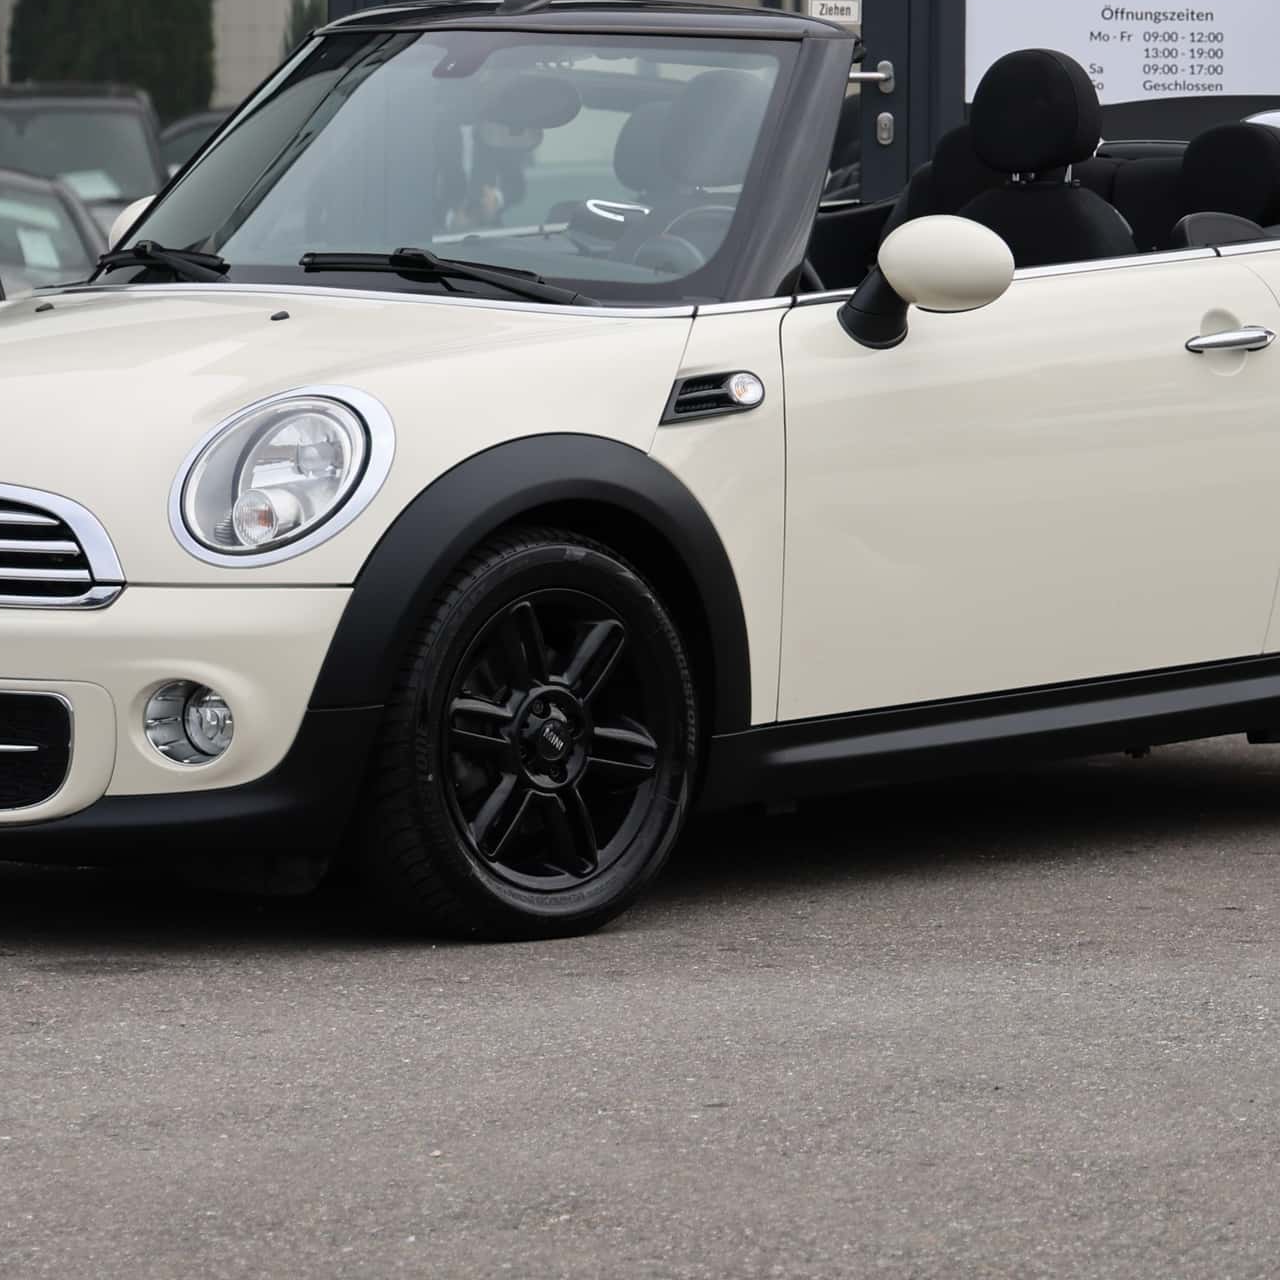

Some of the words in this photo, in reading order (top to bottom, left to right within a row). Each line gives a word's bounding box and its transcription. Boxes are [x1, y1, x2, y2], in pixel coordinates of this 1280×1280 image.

[819, 3, 852, 16] Ziehen
[1101, 4, 1214, 24] Öffnungszeiten
[1089, 31, 1110, 42] Mo
[1120, 31, 1132, 42] Fr
[1143, 31, 1178, 42] 09:00
[1190, 31, 1224, 43] 12:00
[1144, 47, 1178, 59] 13:00
[1189, 47, 1224, 59] 19:00
[1089, 63, 1104, 75] Sa
[1143, 63, 1178, 75] 09:00
[1189, 63, 1224, 76] 17:00
[1143, 80, 1223, 92] Geschlossen
